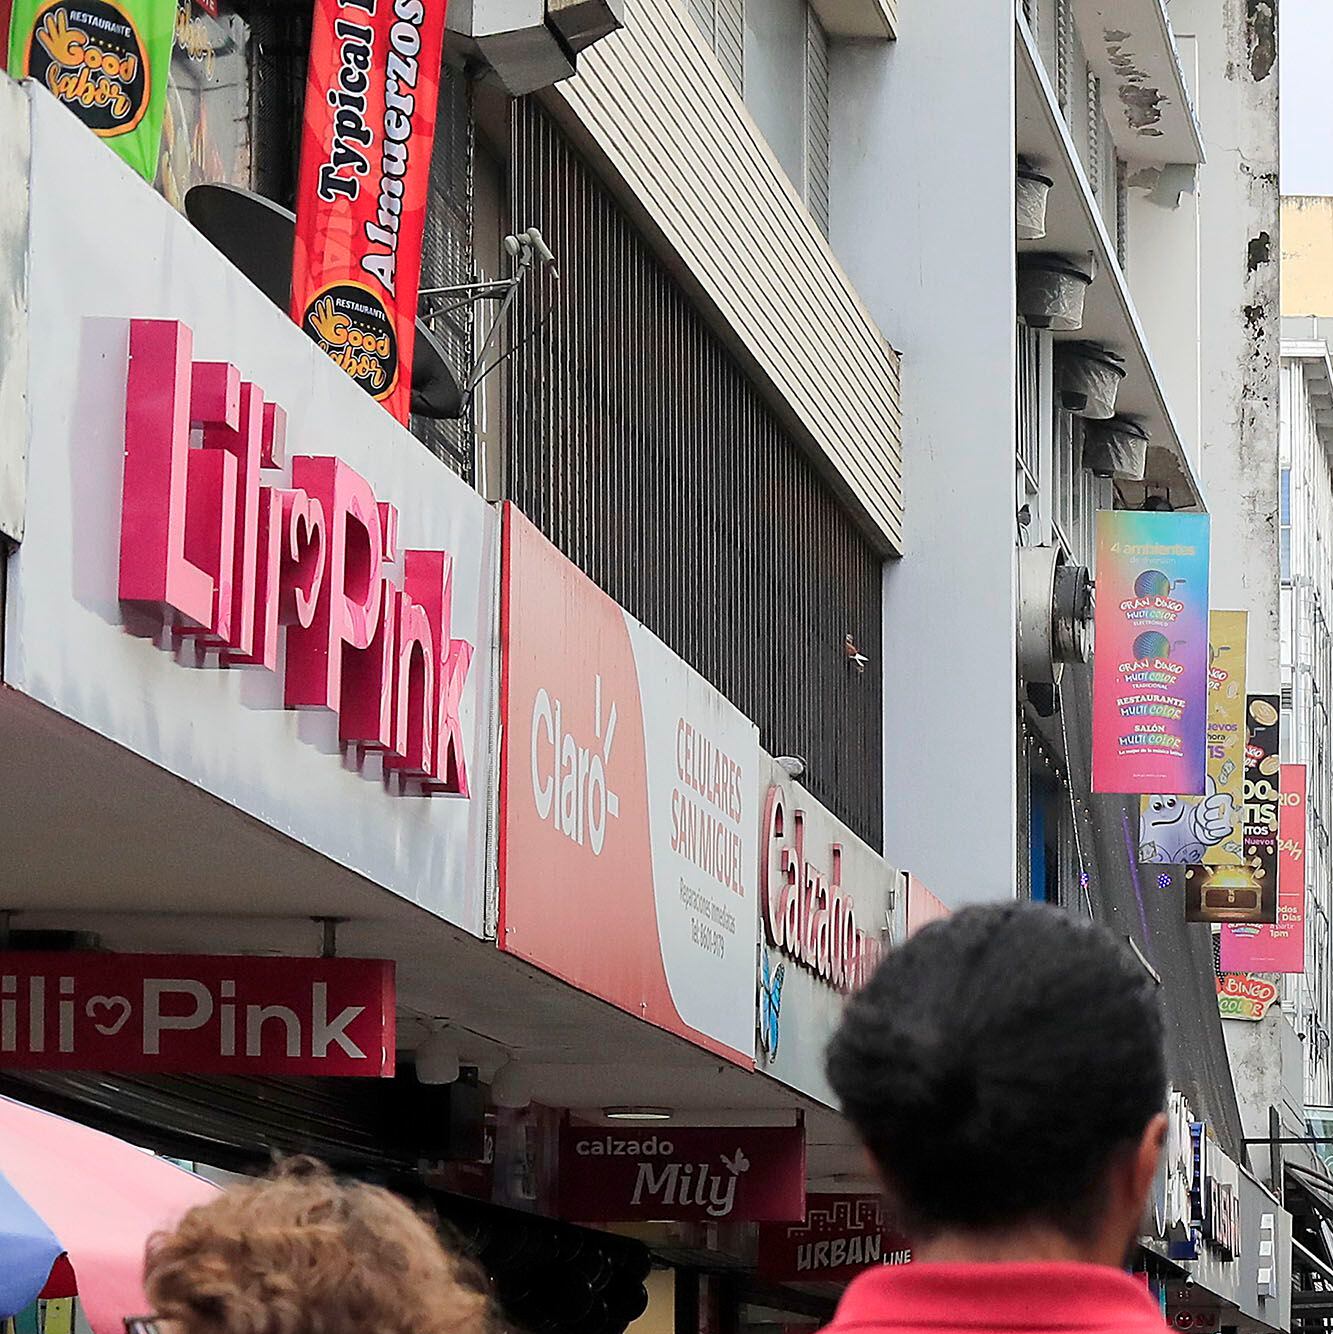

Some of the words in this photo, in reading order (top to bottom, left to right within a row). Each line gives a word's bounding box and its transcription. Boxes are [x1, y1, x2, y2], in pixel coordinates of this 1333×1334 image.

[70, 10, 131, 38] RESTAURANTE
[47, 18, 137, 83] Good
[316, 20, 376, 203] Typical
[361, 0, 425, 297] Almuerzos
[324, 310, 390, 360] Good
[1110, 541, 1120, 555] 4
[285, 455, 475, 799] Pink
[1120, 597, 1150, 611] GRAN
[1154, 597, 1184, 611] BINGO
[1119, 660, 1150, 674] GRAN
[1154, 659, 1184, 675] BINGO
[1116, 694, 1186, 708] RESTAURANTE
[1134, 722, 1166, 733] SALÓN
[531, 688, 607, 856] Claro
[677, 717, 743, 825] CELULARES
[671, 788, 698, 865] SAN
[698, 813, 745, 898] MIGUEL
[761, 783, 856, 992] Calzado
[1270, 930, 1289, 939] 1pm
[1227, 978, 1272, 1000] BINGO
[0, 975, 75, 1054] ili
[143, 977, 368, 1059] Pink
[575, 1135, 674, 1157] calzado
[629, 1161, 738, 1217] Mily
[796, 1233, 882, 1272] URBAN
[882, 1248, 912, 1267] LINE
